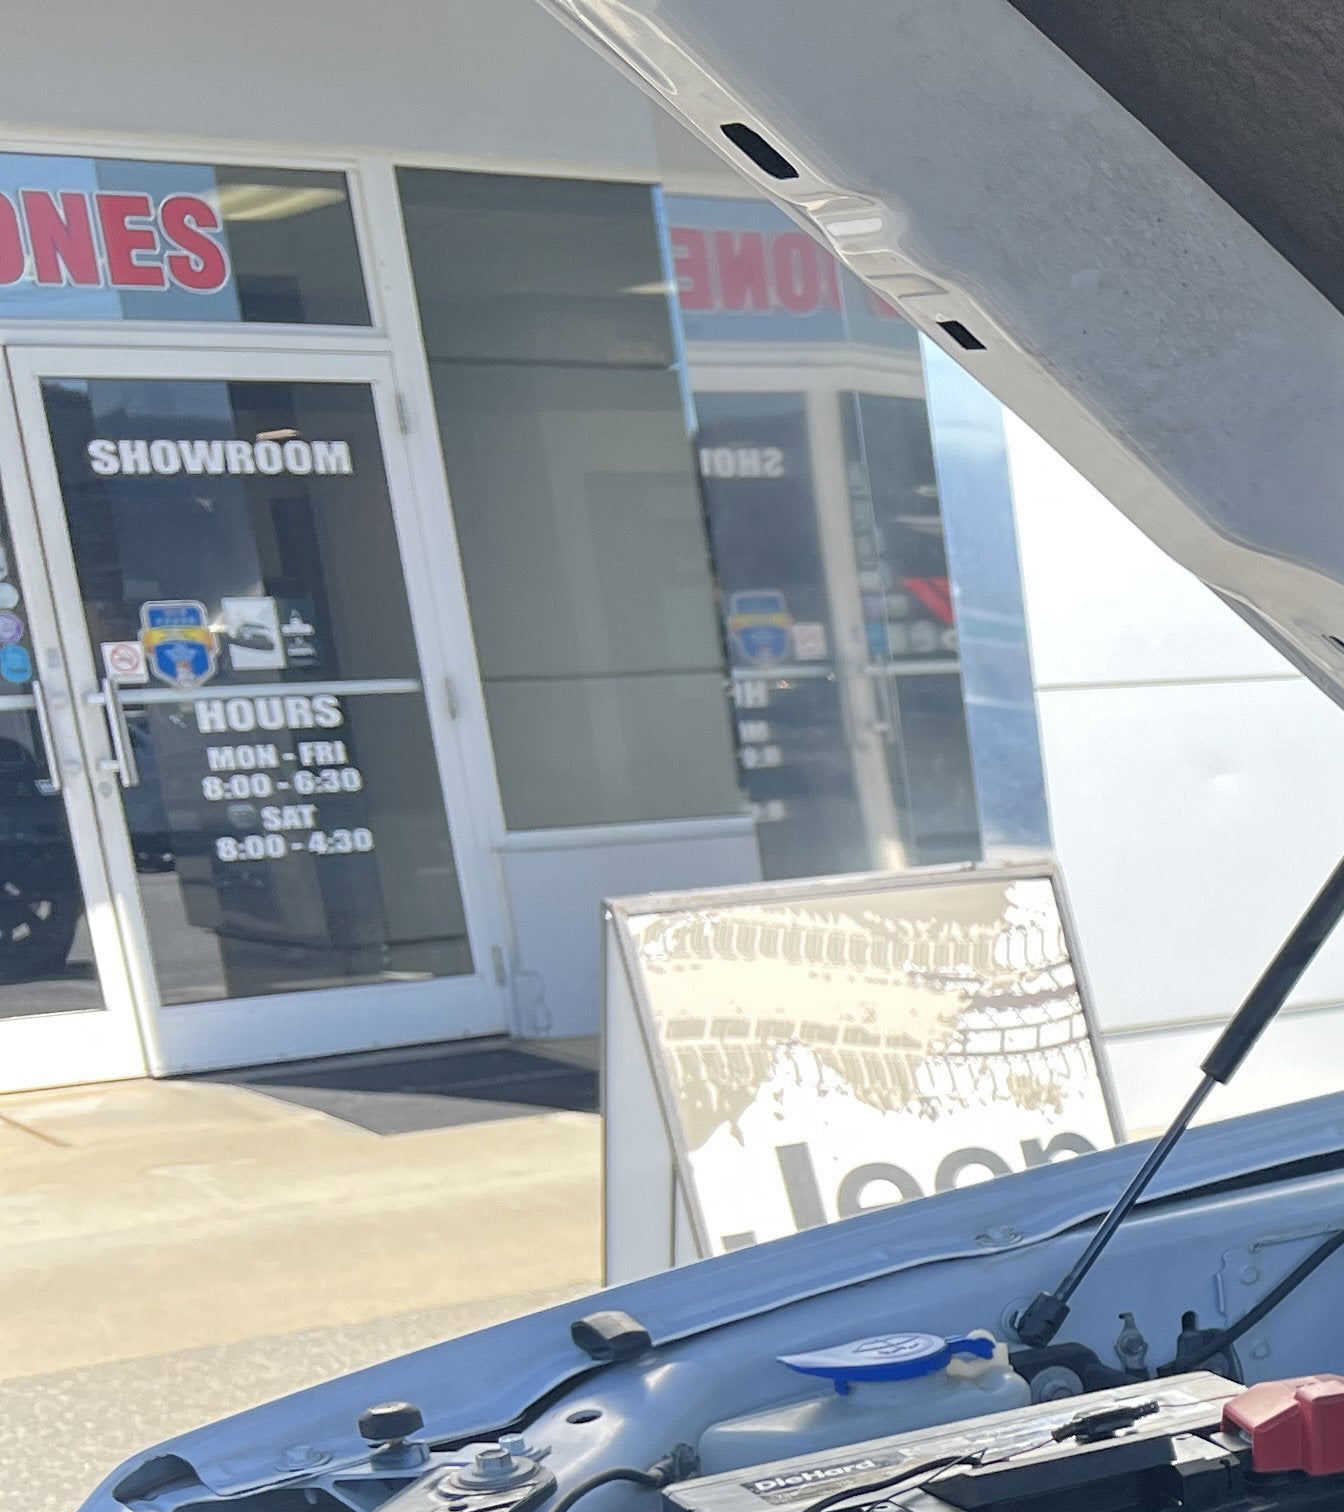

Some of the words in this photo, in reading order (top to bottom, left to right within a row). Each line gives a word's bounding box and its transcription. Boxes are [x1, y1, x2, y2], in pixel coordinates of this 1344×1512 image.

[88, 438, 353, 477] SHOWROOM
[194, 694, 343, 733] HOURS
[207, 744, 280, 771] MON
[298, 741, 348, 766] FRI
[202, 773, 273, 800] 8:00
[293, 767, 362, 794] 6:30
[261, 804, 317, 831] SAT
[215, 834, 286, 862] 8:00
[309, 828, 375, 854] 4:30
[754, 1459, 875, 1491] DieHard
